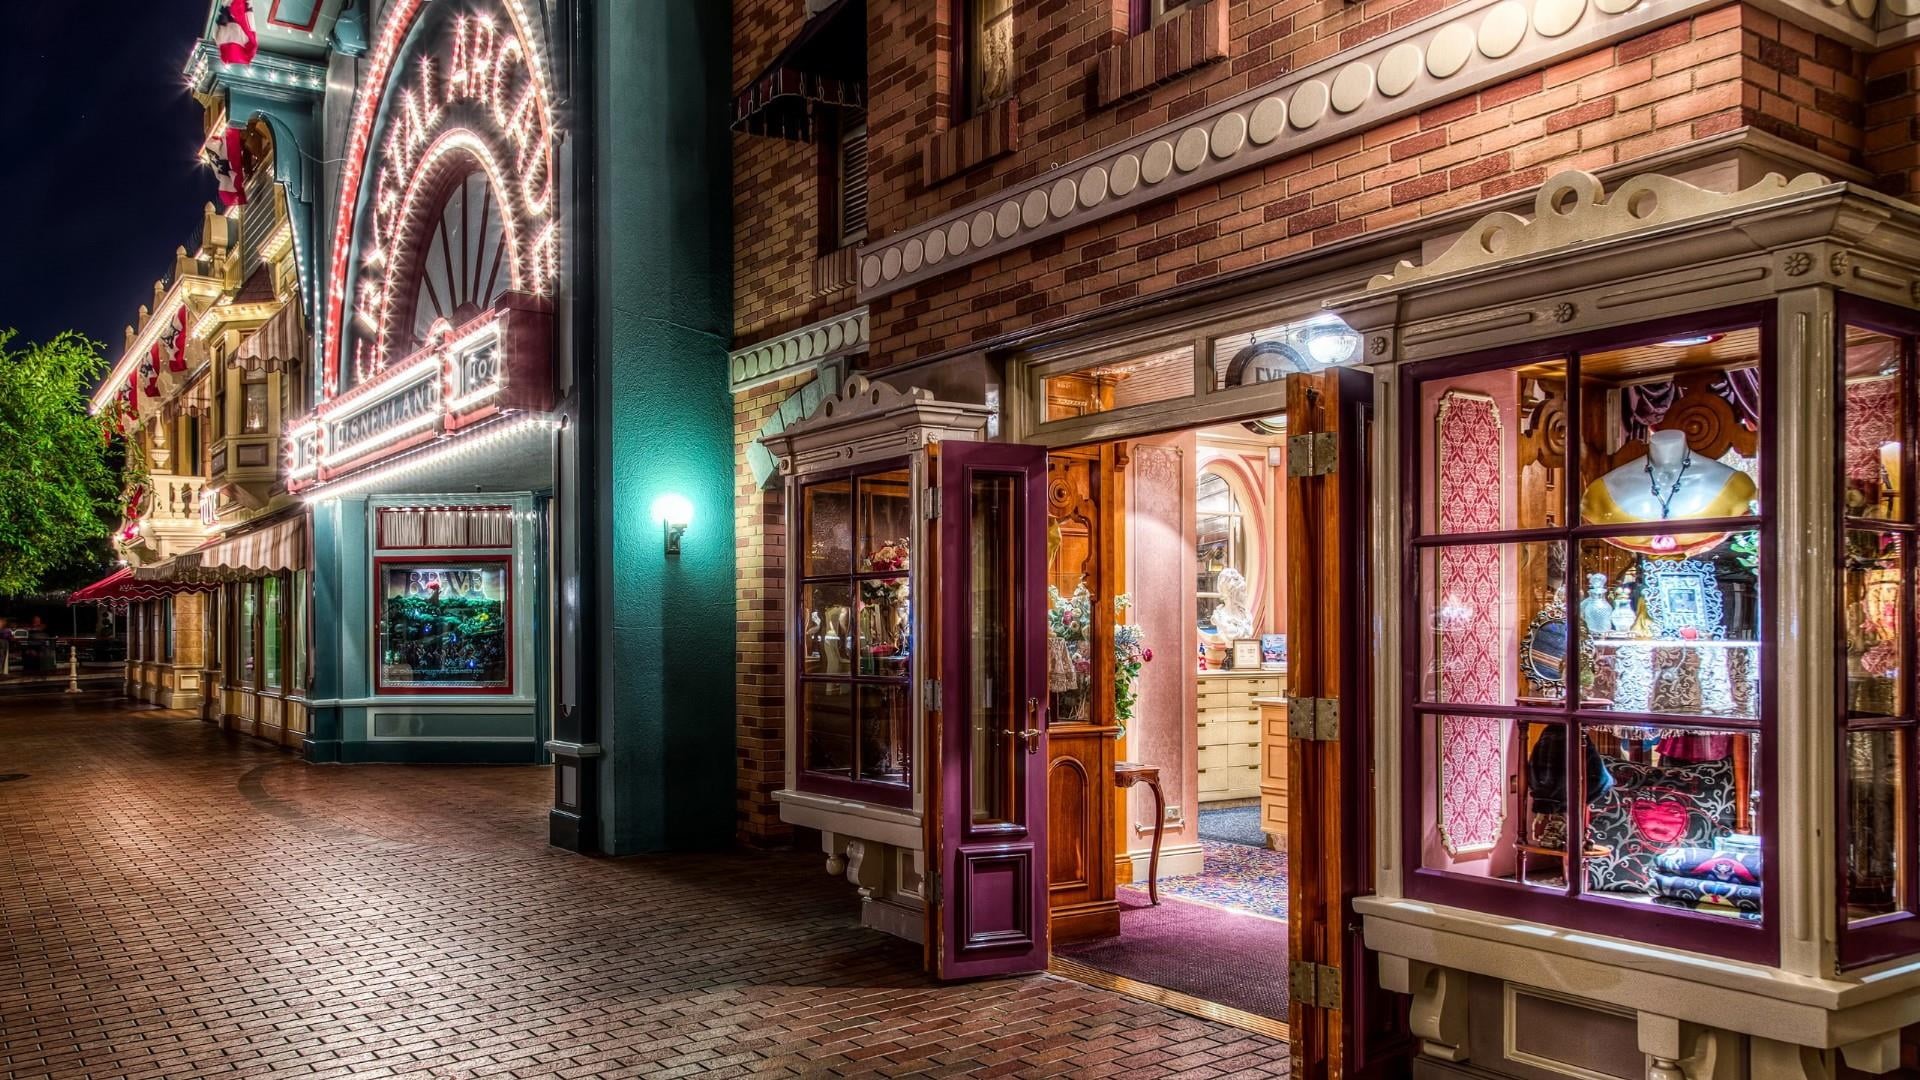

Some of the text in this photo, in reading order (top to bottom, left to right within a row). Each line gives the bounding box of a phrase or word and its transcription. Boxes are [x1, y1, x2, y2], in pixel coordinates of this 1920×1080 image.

[446, 14, 556, 293] ARCADE
[338, 382, 438, 446] DISNEYLAND
[404, 570, 488, 600] BRAVE
